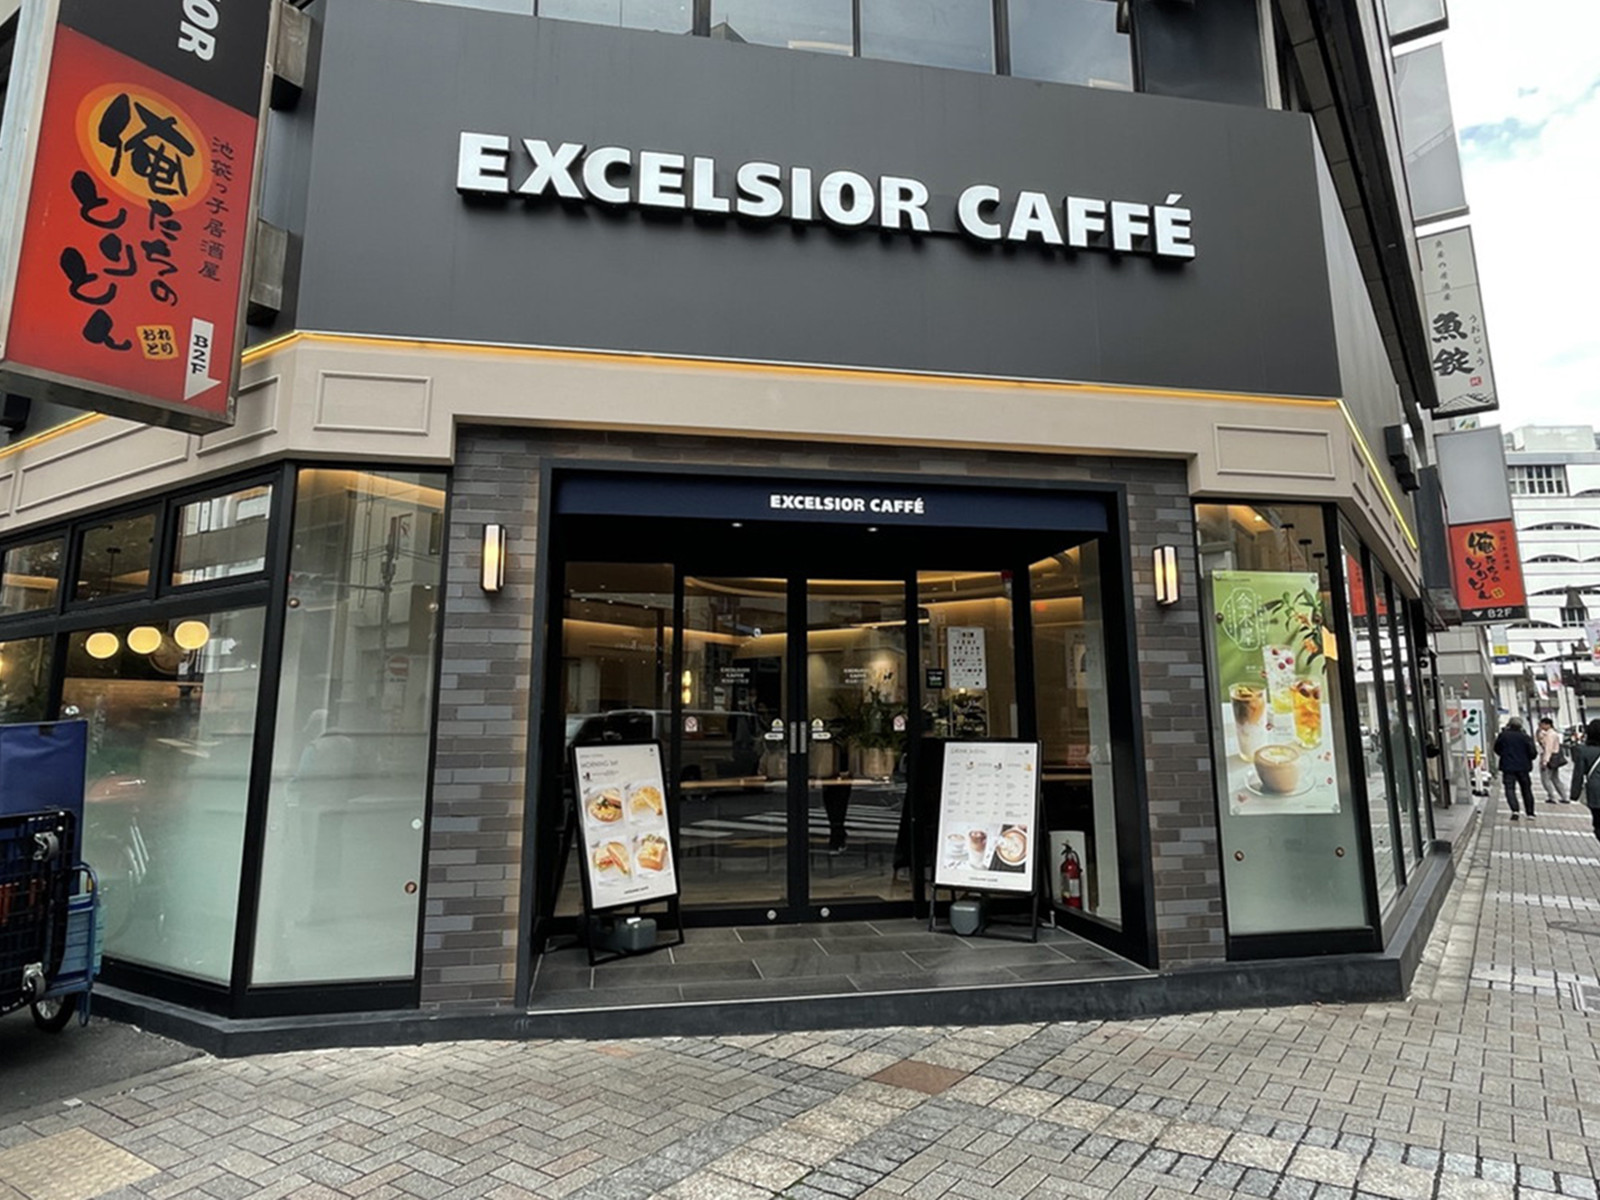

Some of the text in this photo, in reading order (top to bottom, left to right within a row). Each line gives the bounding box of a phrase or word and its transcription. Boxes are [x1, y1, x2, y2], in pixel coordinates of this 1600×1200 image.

[178, 0, 220, 61] OR
[98, 93, 195, 306] 俺たちの
[198, 136, 234, 282] 池袋っ子居酒屋
[457, 132, 1195, 257] EXCELSIOR CAFFÉ
[60, 170, 137, 351] とりとん
[142, 328, 171, 342] おれ
[147, 341, 174, 356] とり
[190, 333, 209, 374] B2F
[770, 495, 925, 514] EXCELSIOR CAFFÉ
[1487, 607, 1512, 619] B2F
